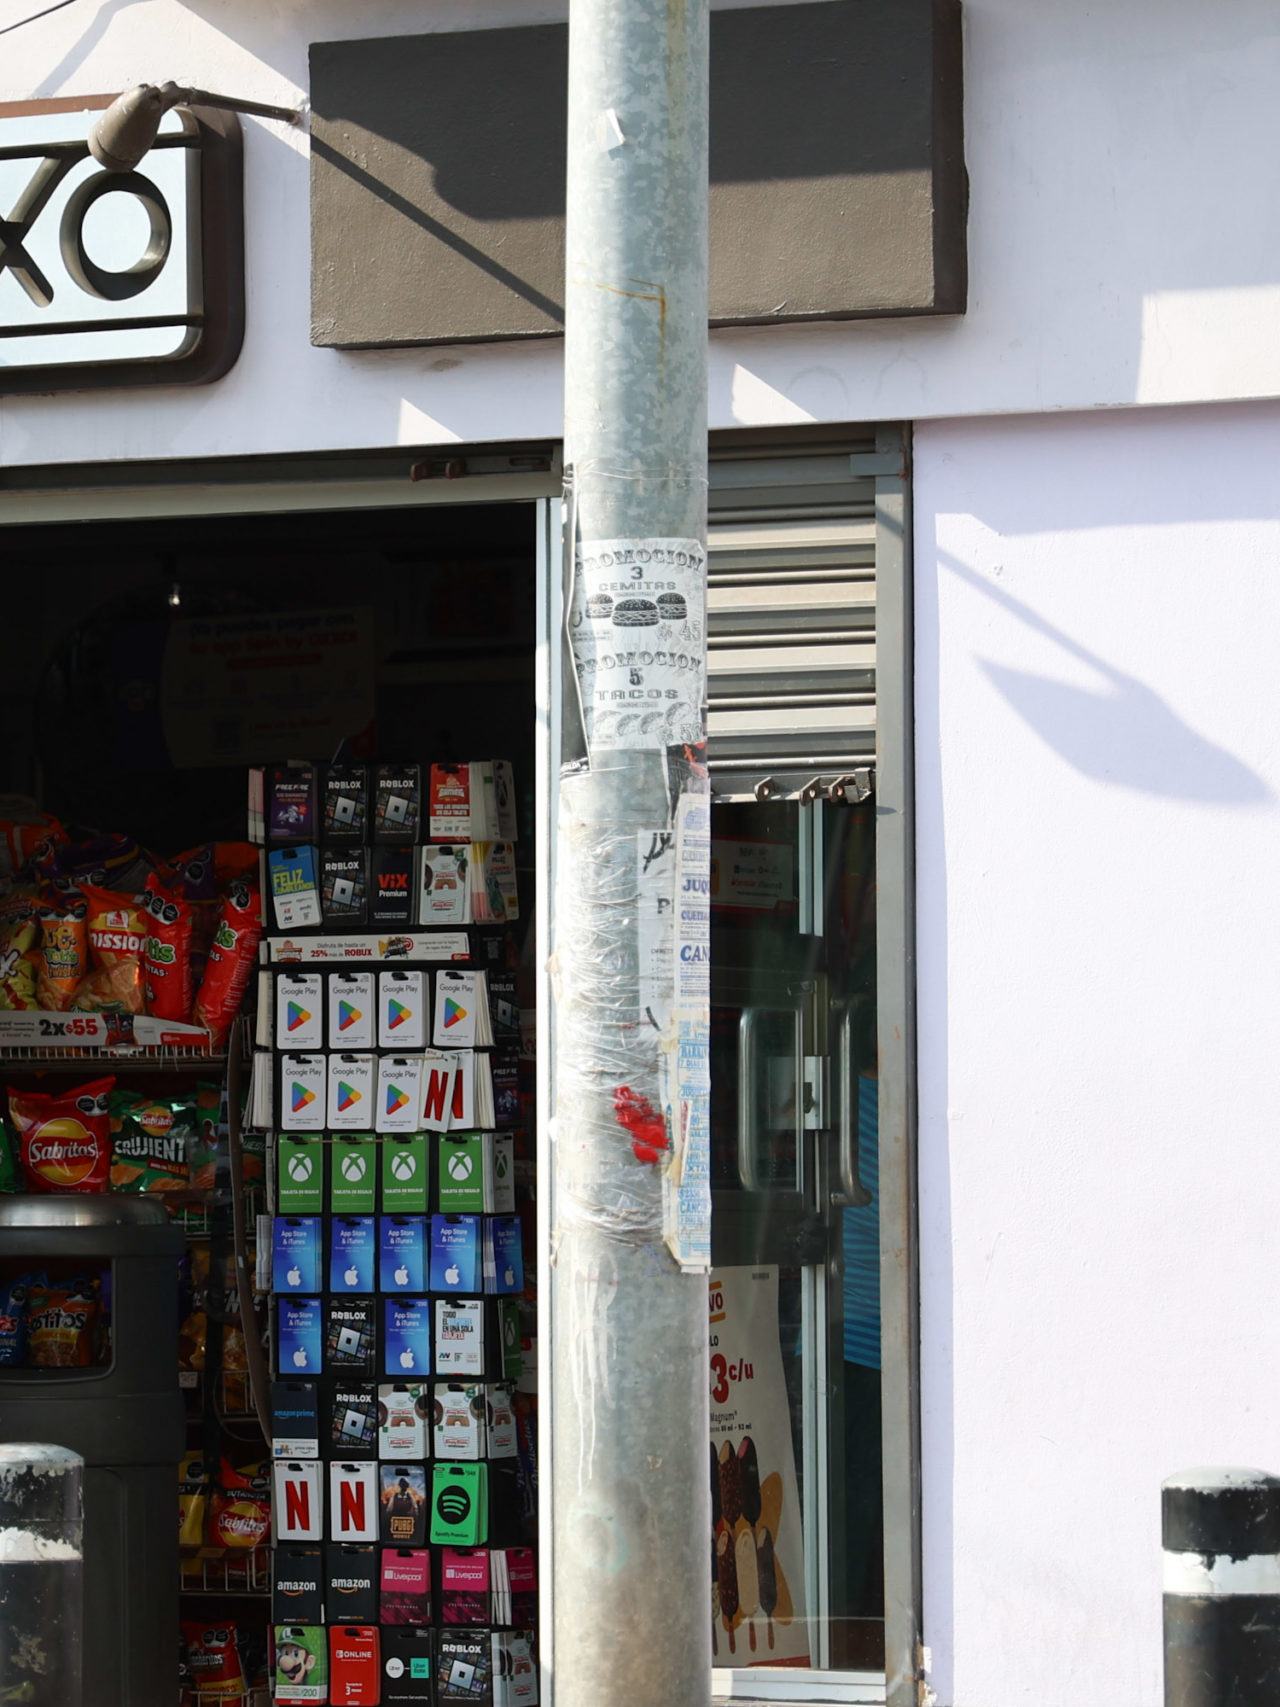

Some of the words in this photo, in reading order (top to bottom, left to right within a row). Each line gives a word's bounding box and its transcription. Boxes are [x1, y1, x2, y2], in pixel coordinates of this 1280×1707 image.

[630, 566, 644, 580] 3
[629, 667, 643, 686] 5
[596, 688, 679, 701] TACOS
[328, 780, 362, 789] ROBLOX
[325, 861, 360, 871] ROBLOX
[272, 868, 304, 889] FELIZ
[377, 873, 408, 889] ViX
[379, 890, 408, 898] Premium
[345, 949, 372, 957] ROBUX
[281, 986, 301, 996] Google
[302, 985, 317, 996] Play
[332, 985, 352, 995] Google
[353, 985, 368, 995] Play
[39, 1018, 98, 1037] 2x$55
[285, 1068, 305, 1078] Google
[306, 1067, 321, 1077] Play
[382, 1070, 400, 1080] Google
[401, 1069, 416, 1080] Play
[29, 1141, 98, 1164] Sabritas
[440, 1228, 451, 1236] App
[451, 1228, 468, 1236] Store
[287, 1311, 297, 1320] App
[298, 1311, 313, 1319] Store
[331, 1311, 366, 1321] ROBLOX
[461, 1325, 474, 1333] SOLA
[729, 1358, 754, 1382] c/u
[336, 1393, 372, 1403] ROBLOX
[218, 1507, 267, 1534] Sabritas
[455, 1570, 483, 1580] Liverpool
[277, 1581, 316, 1591] amazon
[331, 1578, 370, 1589] amazon
[442, 1644, 482, 1654] ROBLOX
